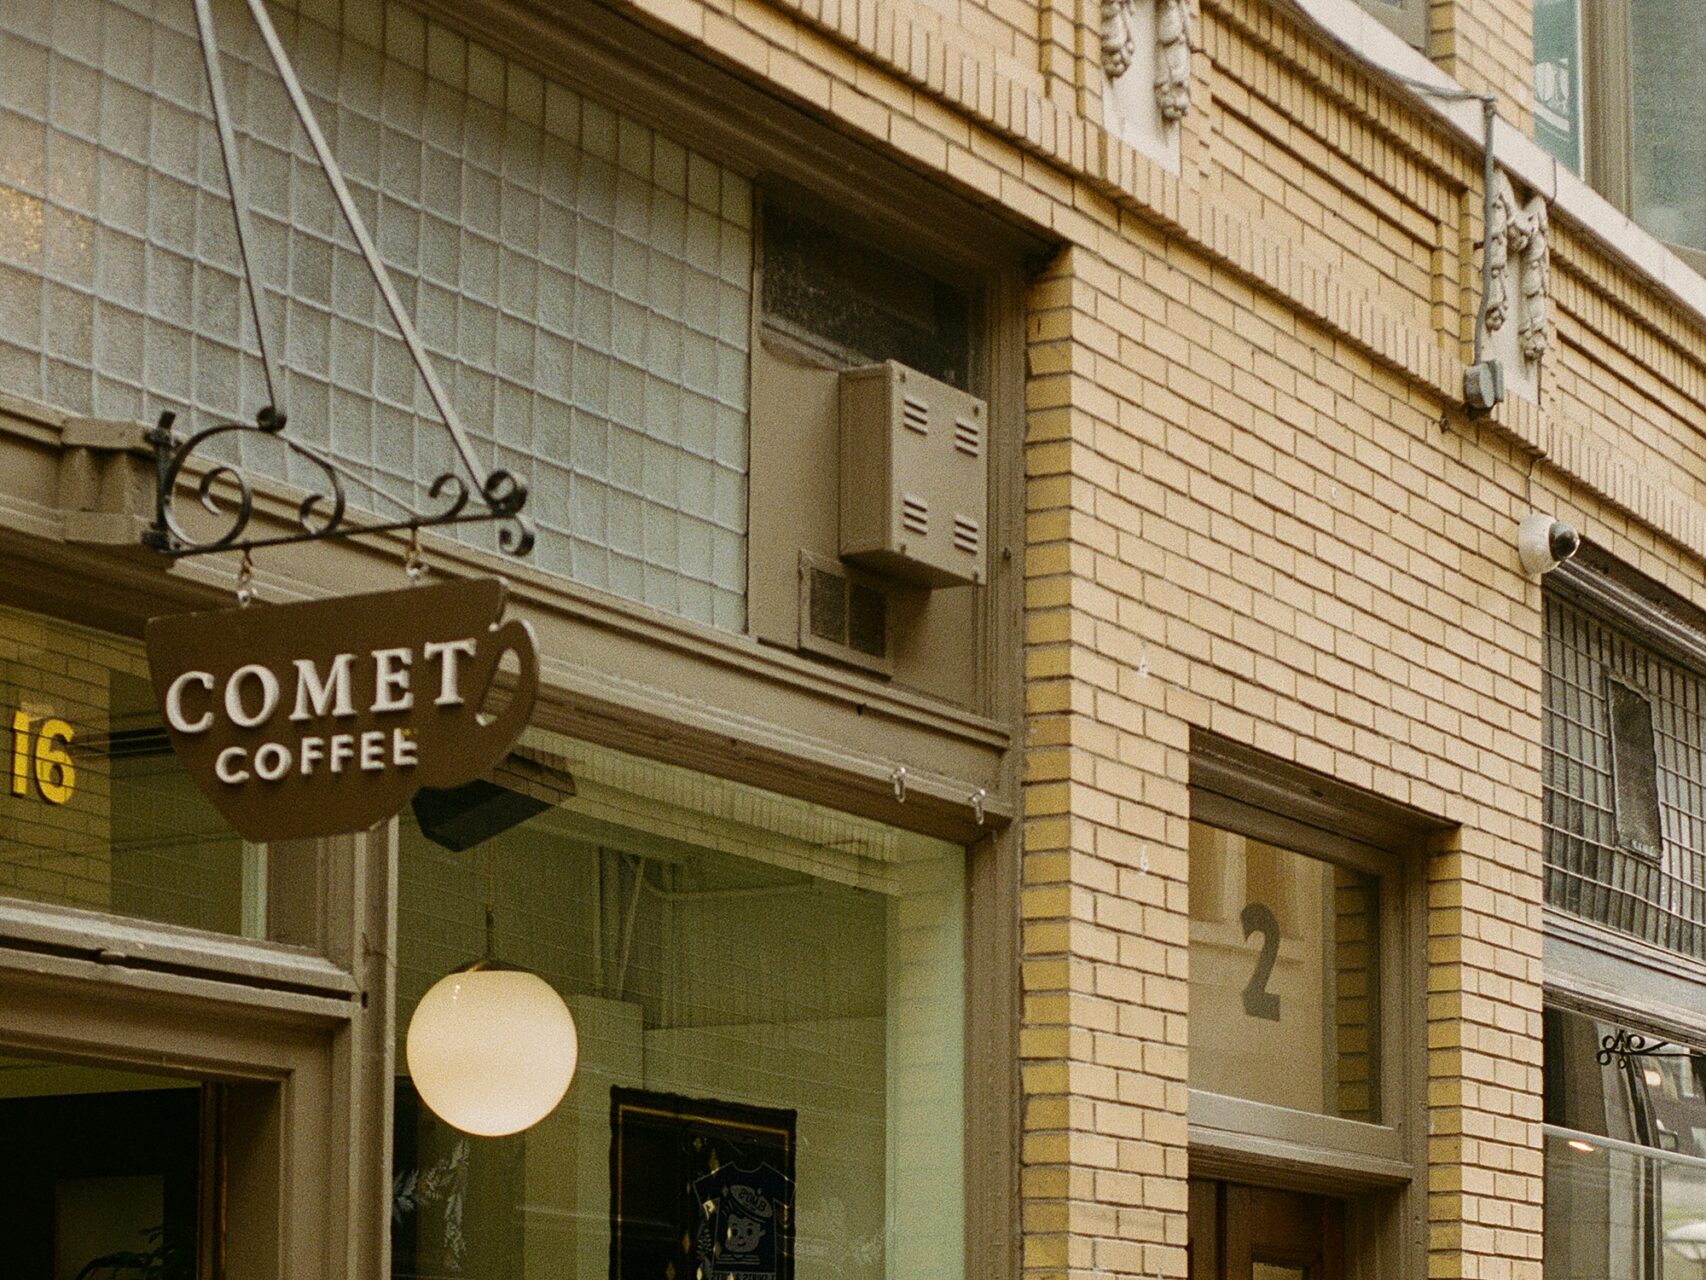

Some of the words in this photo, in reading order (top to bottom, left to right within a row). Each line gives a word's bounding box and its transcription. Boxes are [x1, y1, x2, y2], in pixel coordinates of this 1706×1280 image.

[166, 639, 477, 734] COMET
[11, 710, 75, 804] 16
[215, 729, 418, 784] COFFEE
[1240, 902, 1281, 1022] 2
